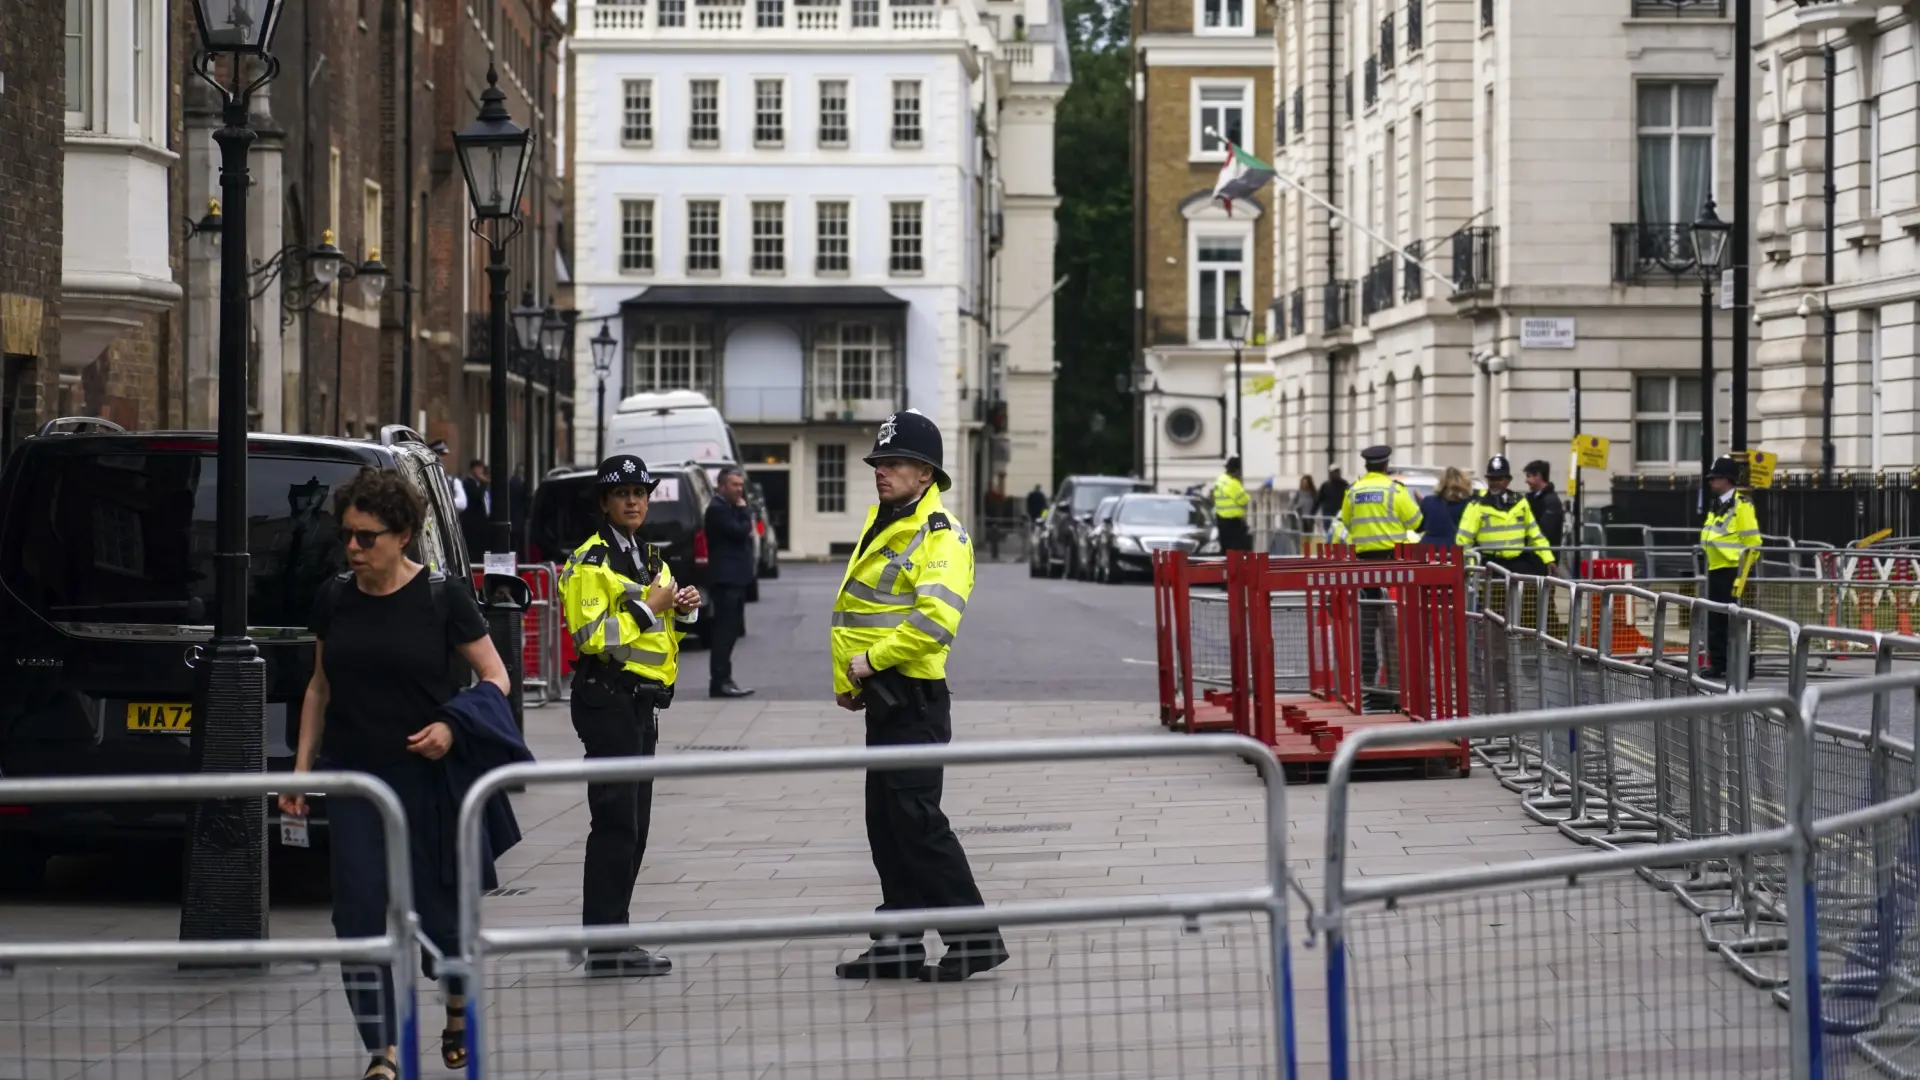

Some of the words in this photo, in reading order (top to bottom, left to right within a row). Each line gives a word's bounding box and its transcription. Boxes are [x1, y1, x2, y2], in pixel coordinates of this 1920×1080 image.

[1525, 319, 1558, 328] RUSSELL
[1525, 329, 1551, 337] COURT
[925, 560, 948, 569] OLICE
[581, 597, 600, 607] OLICE
